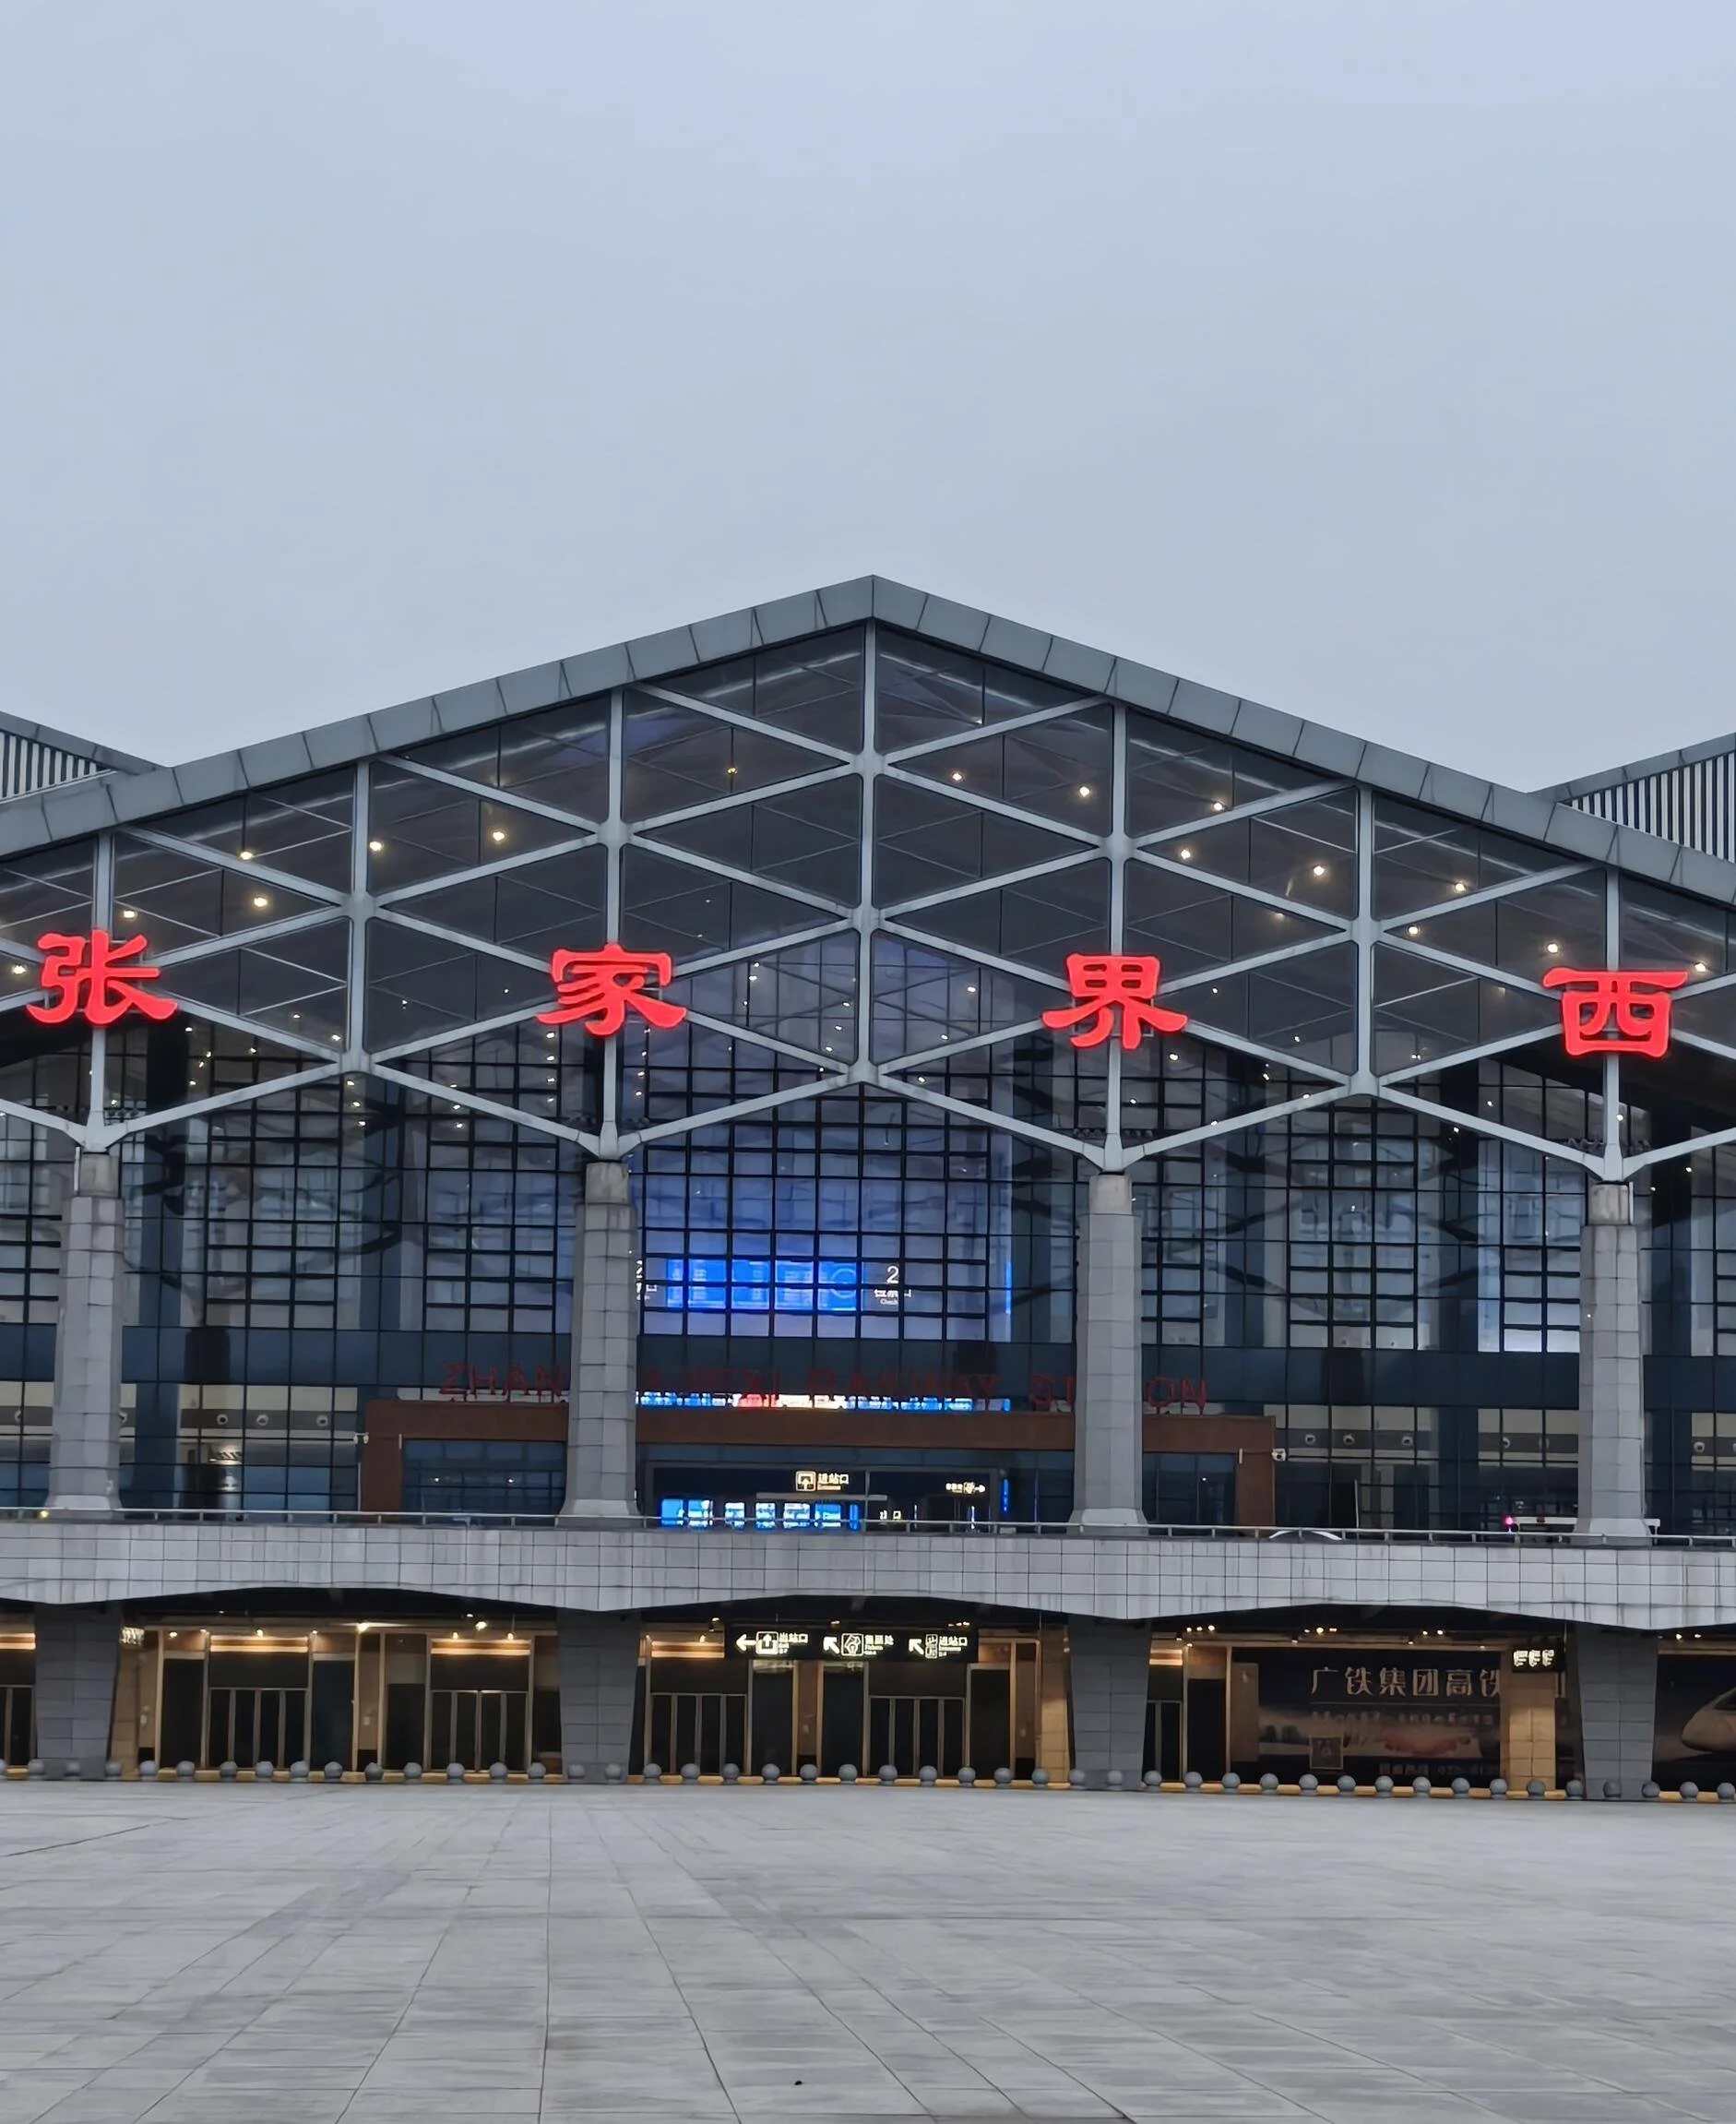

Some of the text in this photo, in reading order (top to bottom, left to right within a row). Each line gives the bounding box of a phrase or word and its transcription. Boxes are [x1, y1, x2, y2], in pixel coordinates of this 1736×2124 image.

[26, 929, 1689, 1058] 张 家 界 西
[886, 1265, 899, 1284] 2
[1310, 1665, 1502, 1698] 广铁集团高铁
